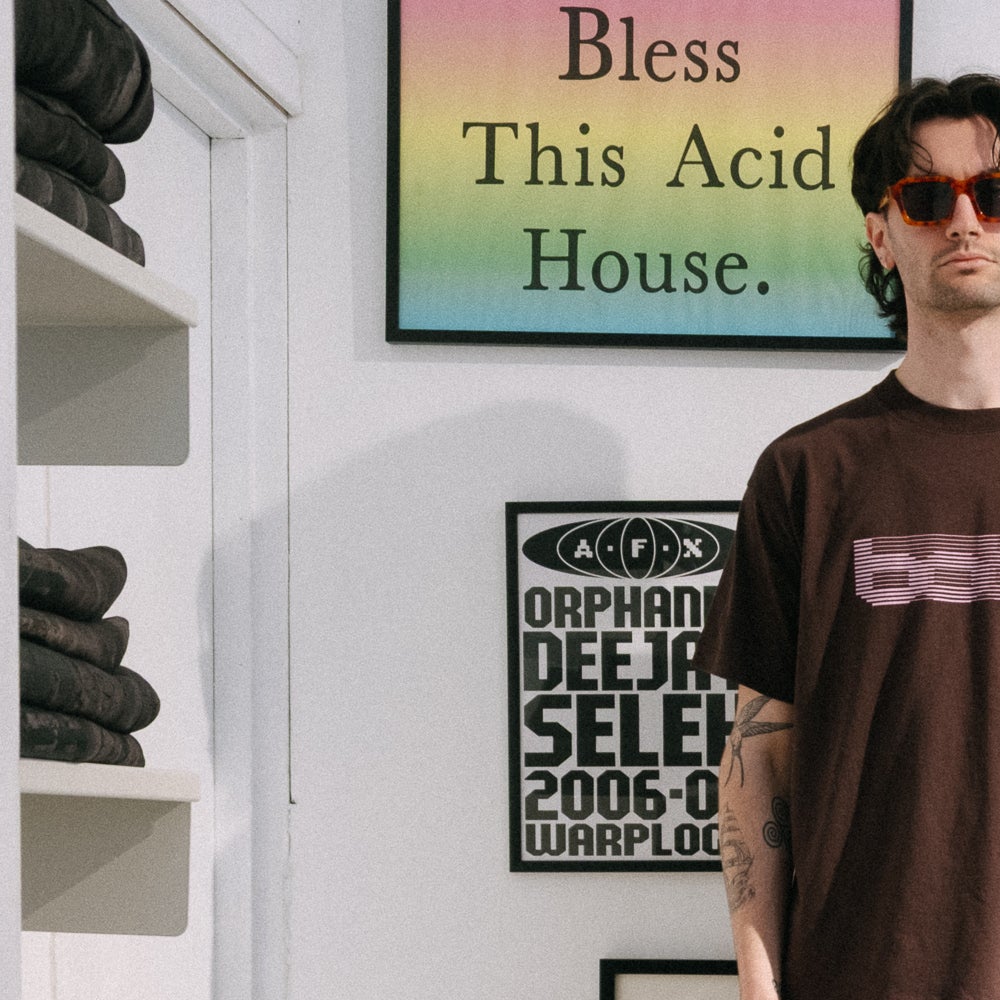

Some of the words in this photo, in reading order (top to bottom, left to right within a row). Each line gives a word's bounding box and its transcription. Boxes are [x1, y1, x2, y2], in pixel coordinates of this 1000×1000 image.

[558, 6, 741, 82] Bless
[461, 121, 625, 187] This
[666, 123, 835, 190] Acid
[522, 228, 769, 295] House.
[523, 631, 738, 691] DEEJA
[524, 770, 719, 820] 2006-0
